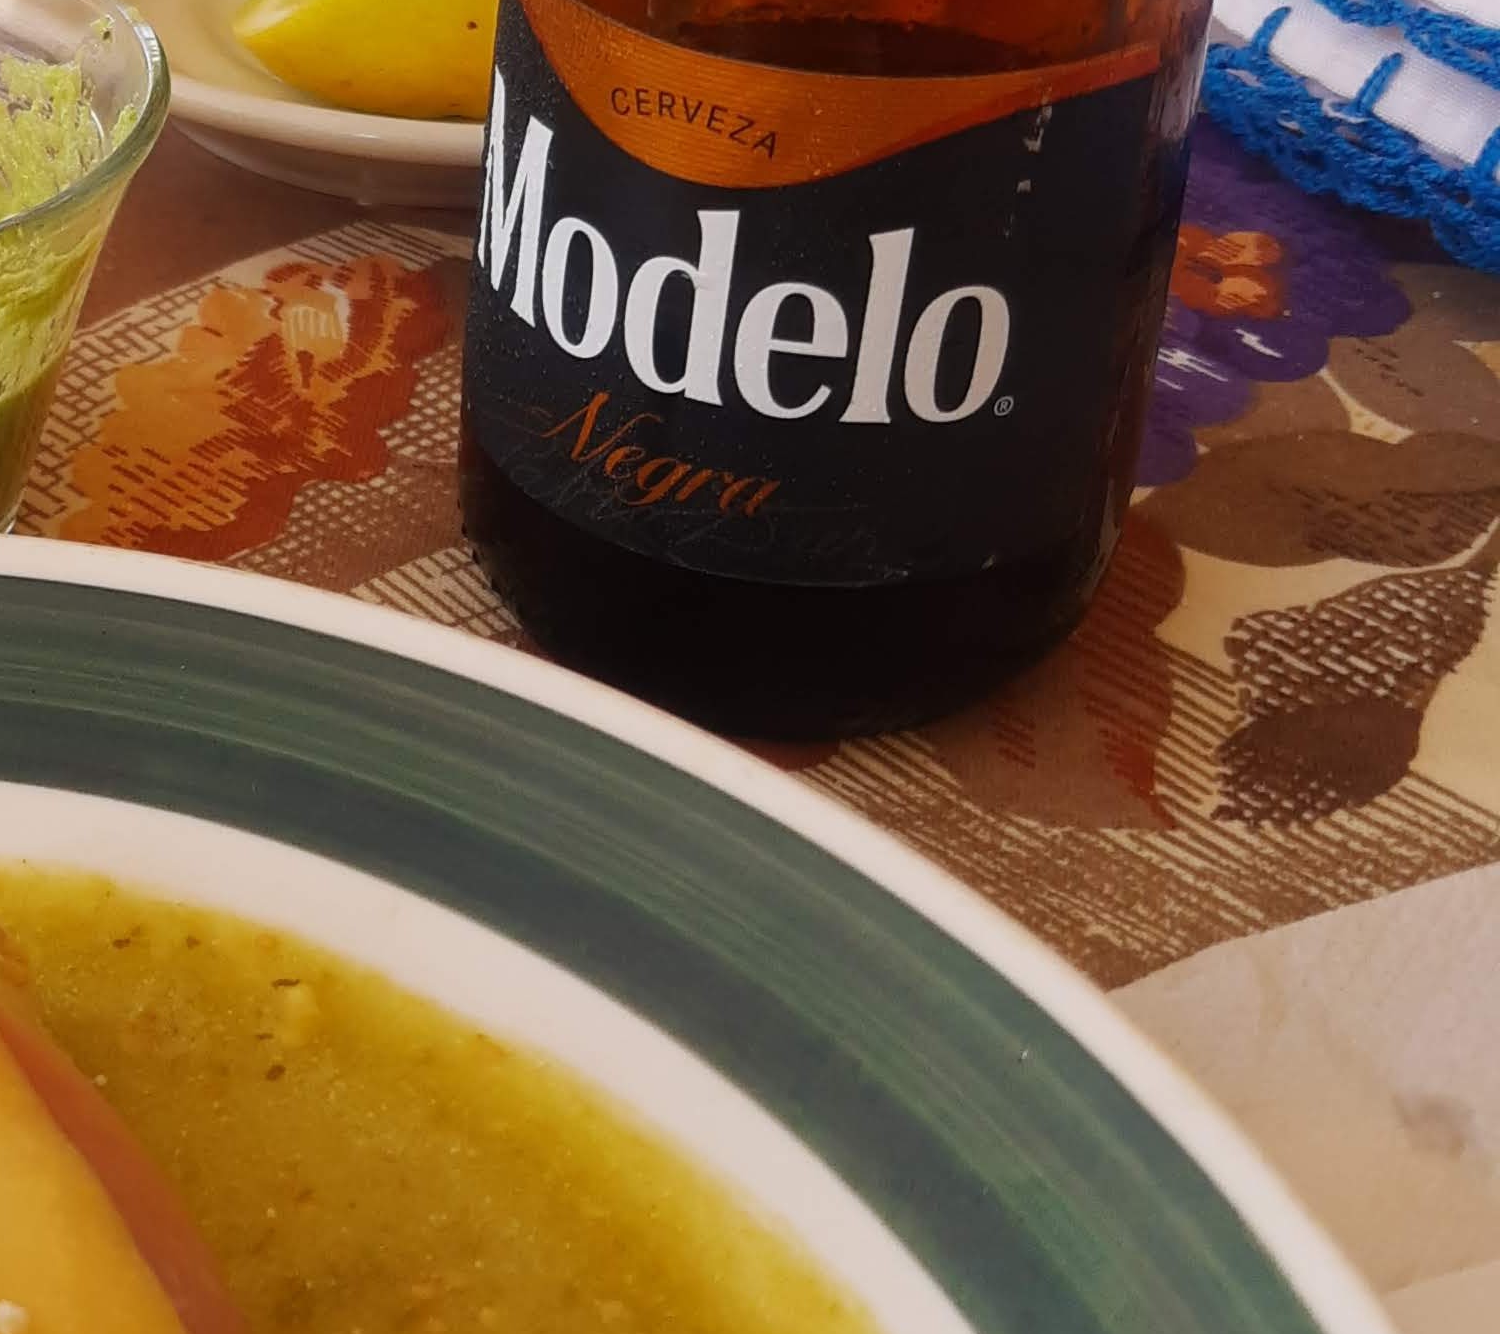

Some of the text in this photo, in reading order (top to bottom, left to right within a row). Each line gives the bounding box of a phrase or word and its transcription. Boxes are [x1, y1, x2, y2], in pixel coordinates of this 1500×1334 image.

[609, 86, 779, 160] CERVEZA
[477, 64, 1011, 424] Modelo
[530, 389, 782, 518] Negra
